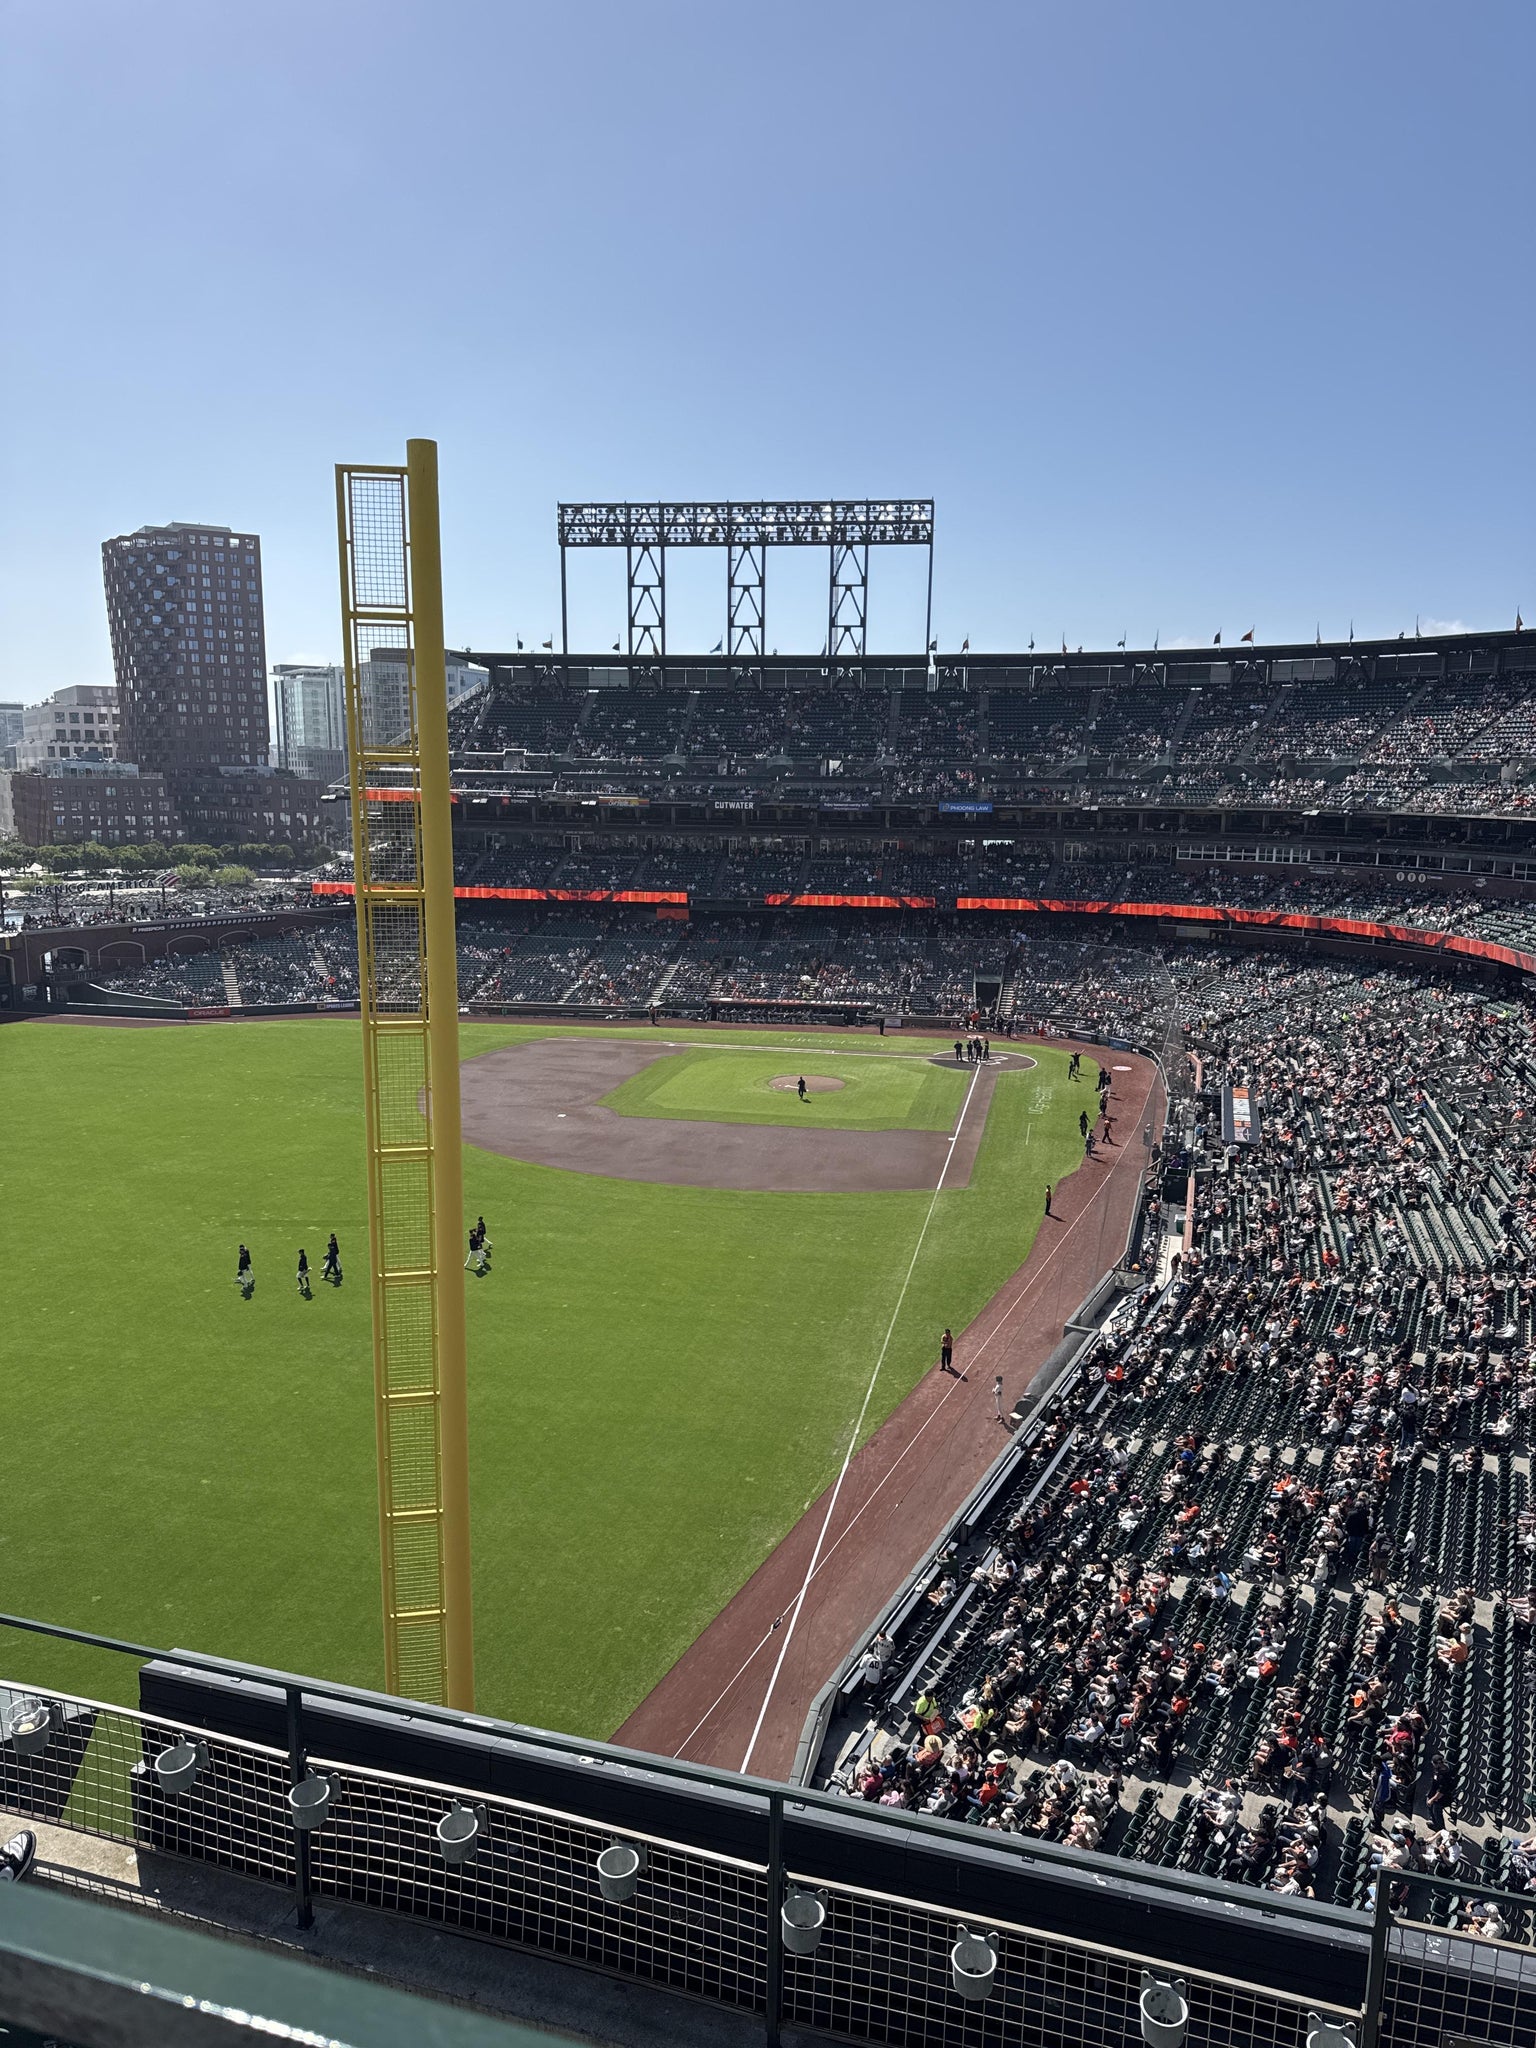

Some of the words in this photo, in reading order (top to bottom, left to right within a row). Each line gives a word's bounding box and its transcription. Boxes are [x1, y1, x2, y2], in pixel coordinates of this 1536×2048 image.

[714, 801, 754, 810] CUTWATER
[35, 883, 74, 896] BANK
[76, 881, 93, 892] OF
[96, 879, 155, 891] AMERICA
[869, 1661, 879, 1669] 40
